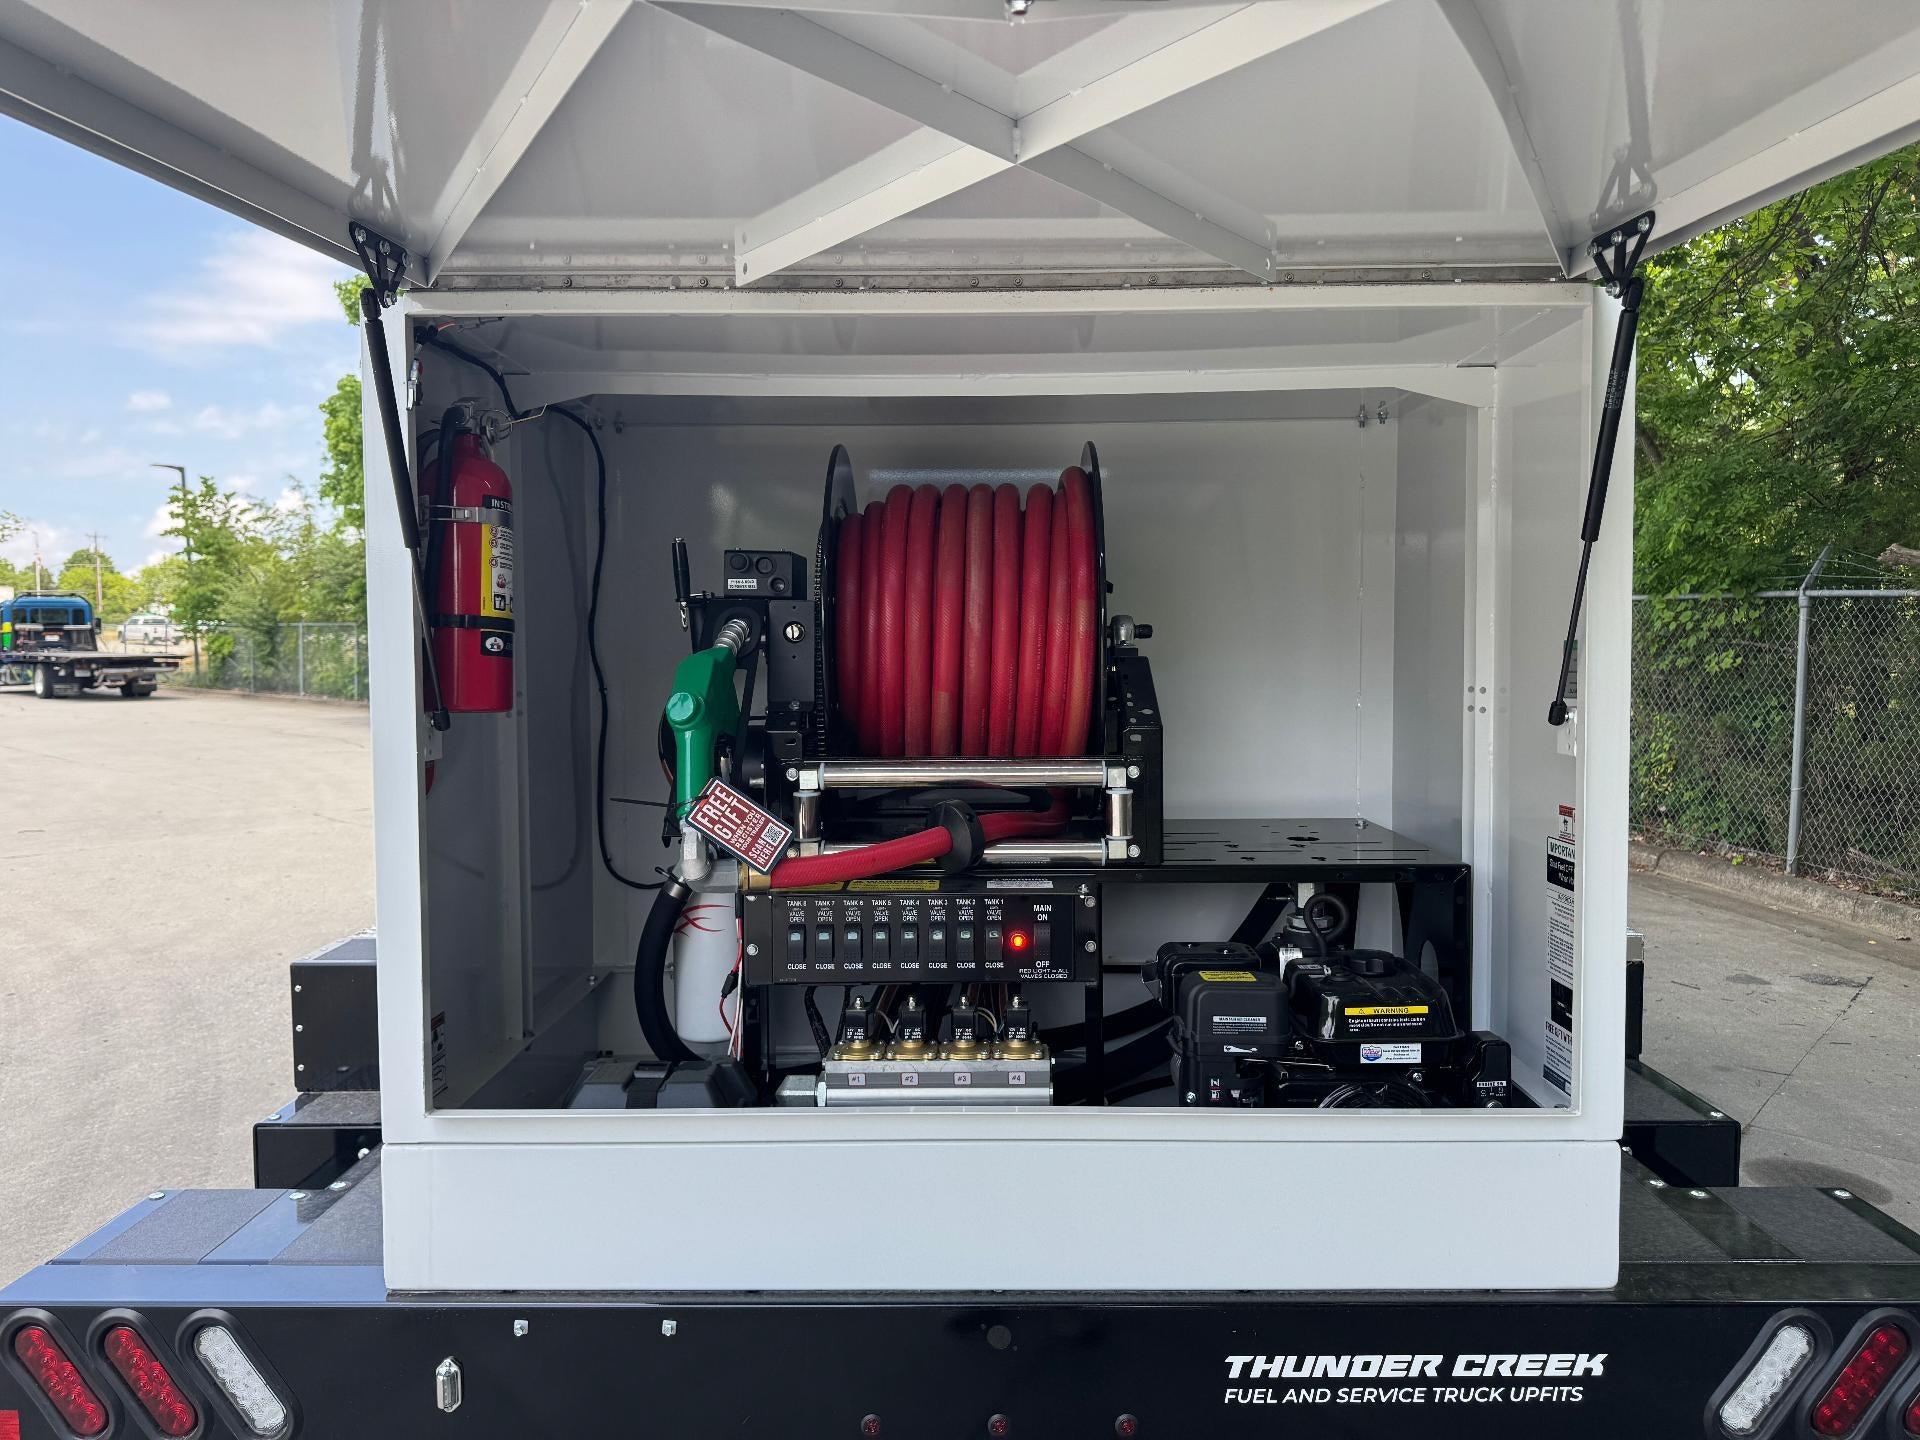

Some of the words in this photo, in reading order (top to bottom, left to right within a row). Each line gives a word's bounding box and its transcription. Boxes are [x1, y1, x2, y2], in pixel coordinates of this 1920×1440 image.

[696, 787, 734, 829] FREE
[713, 798, 749, 840] GIFT
[730, 825, 747, 844] WHEN
[744, 810, 756, 823] YOU
[735, 813, 762, 848] REGISTER
[749, 838, 766, 859] SCAN
[757, 843, 775, 865] HERE
[1224, 1354, 1444, 1378] THUNDER
[1452, 1353, 1608, 1376] CREEK
[1224, 1388, 1277, 1404] FUEL
[1282, 1388, 1330, 1403] AND
[1336, 1387, 1426, 1403] SERVICE
[1433, 1387, 1504, 1402] TRUCK
[1509, 1386, 1584, 1402] UPFITS
